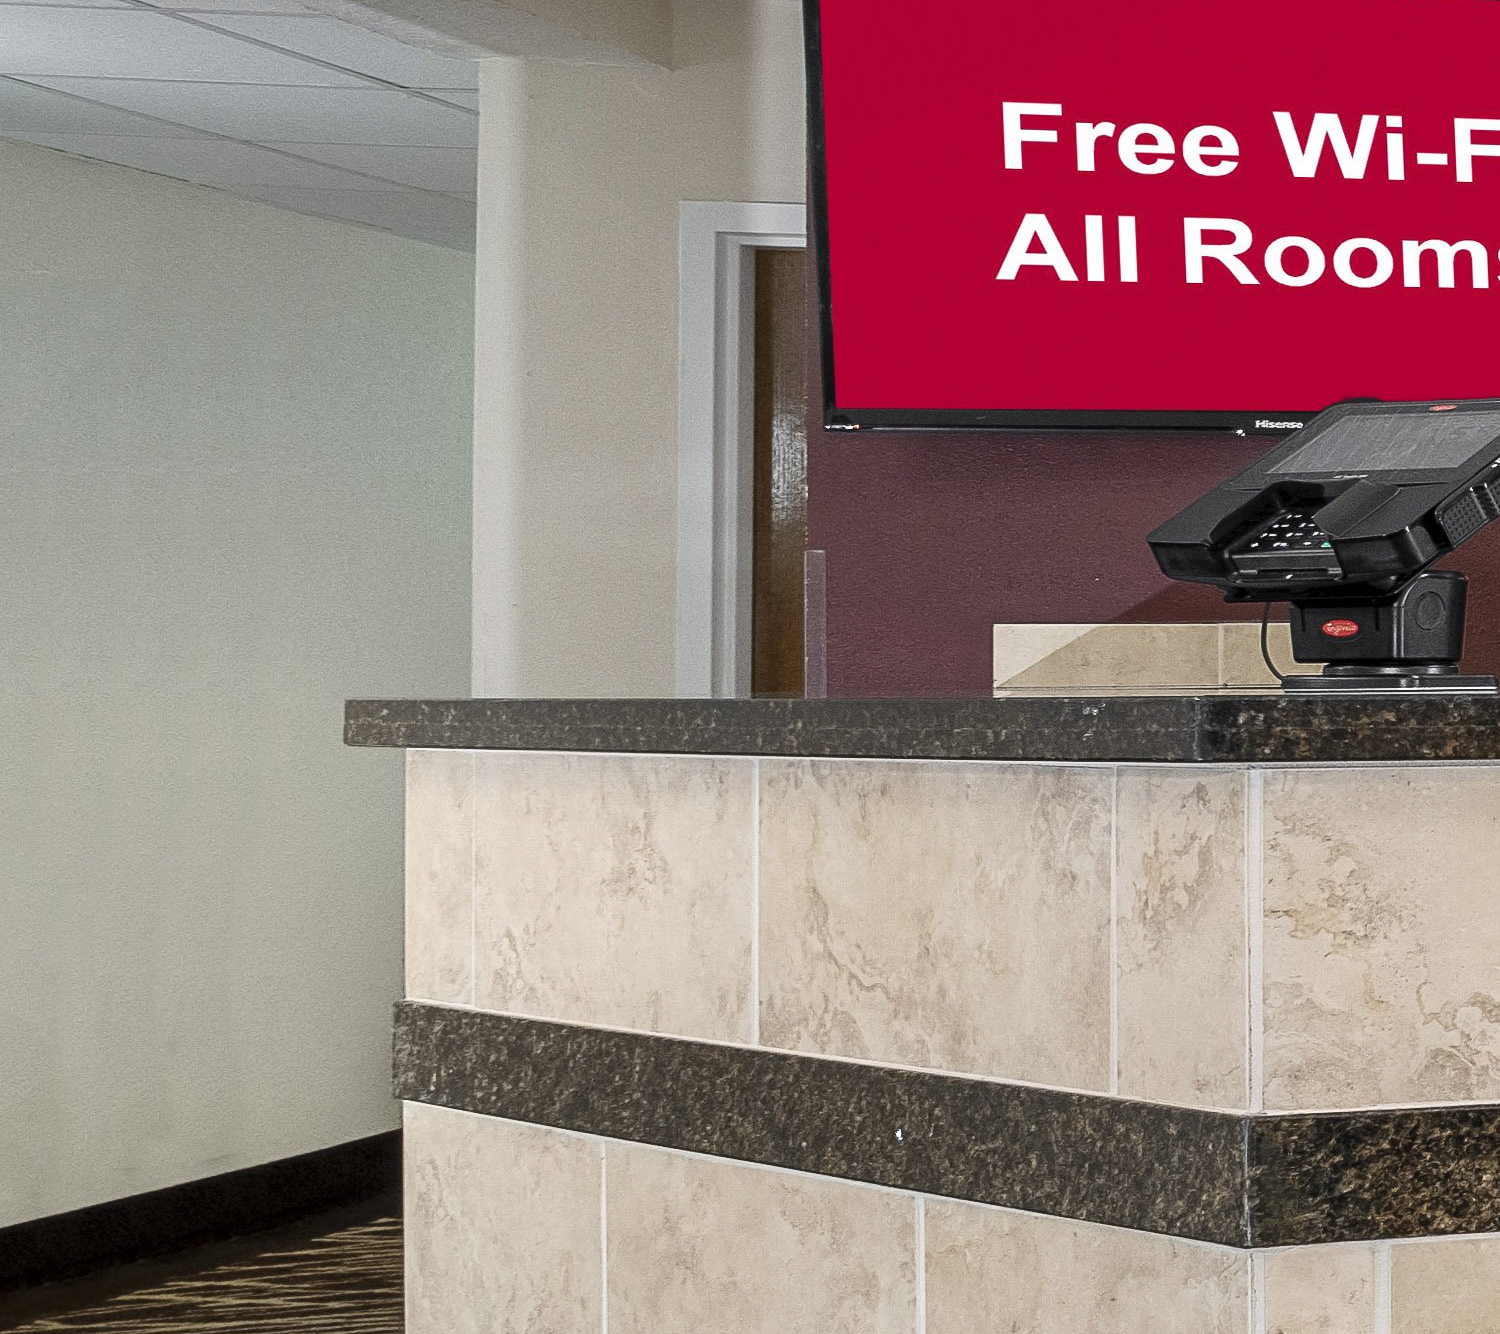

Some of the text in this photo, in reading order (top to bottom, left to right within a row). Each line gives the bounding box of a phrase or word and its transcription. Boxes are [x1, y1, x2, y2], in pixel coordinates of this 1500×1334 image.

[1002, 101, 1240, 177] Free
[995, 213, 1139, 283] All
[1254, 419, 1304, 429] Hisense
